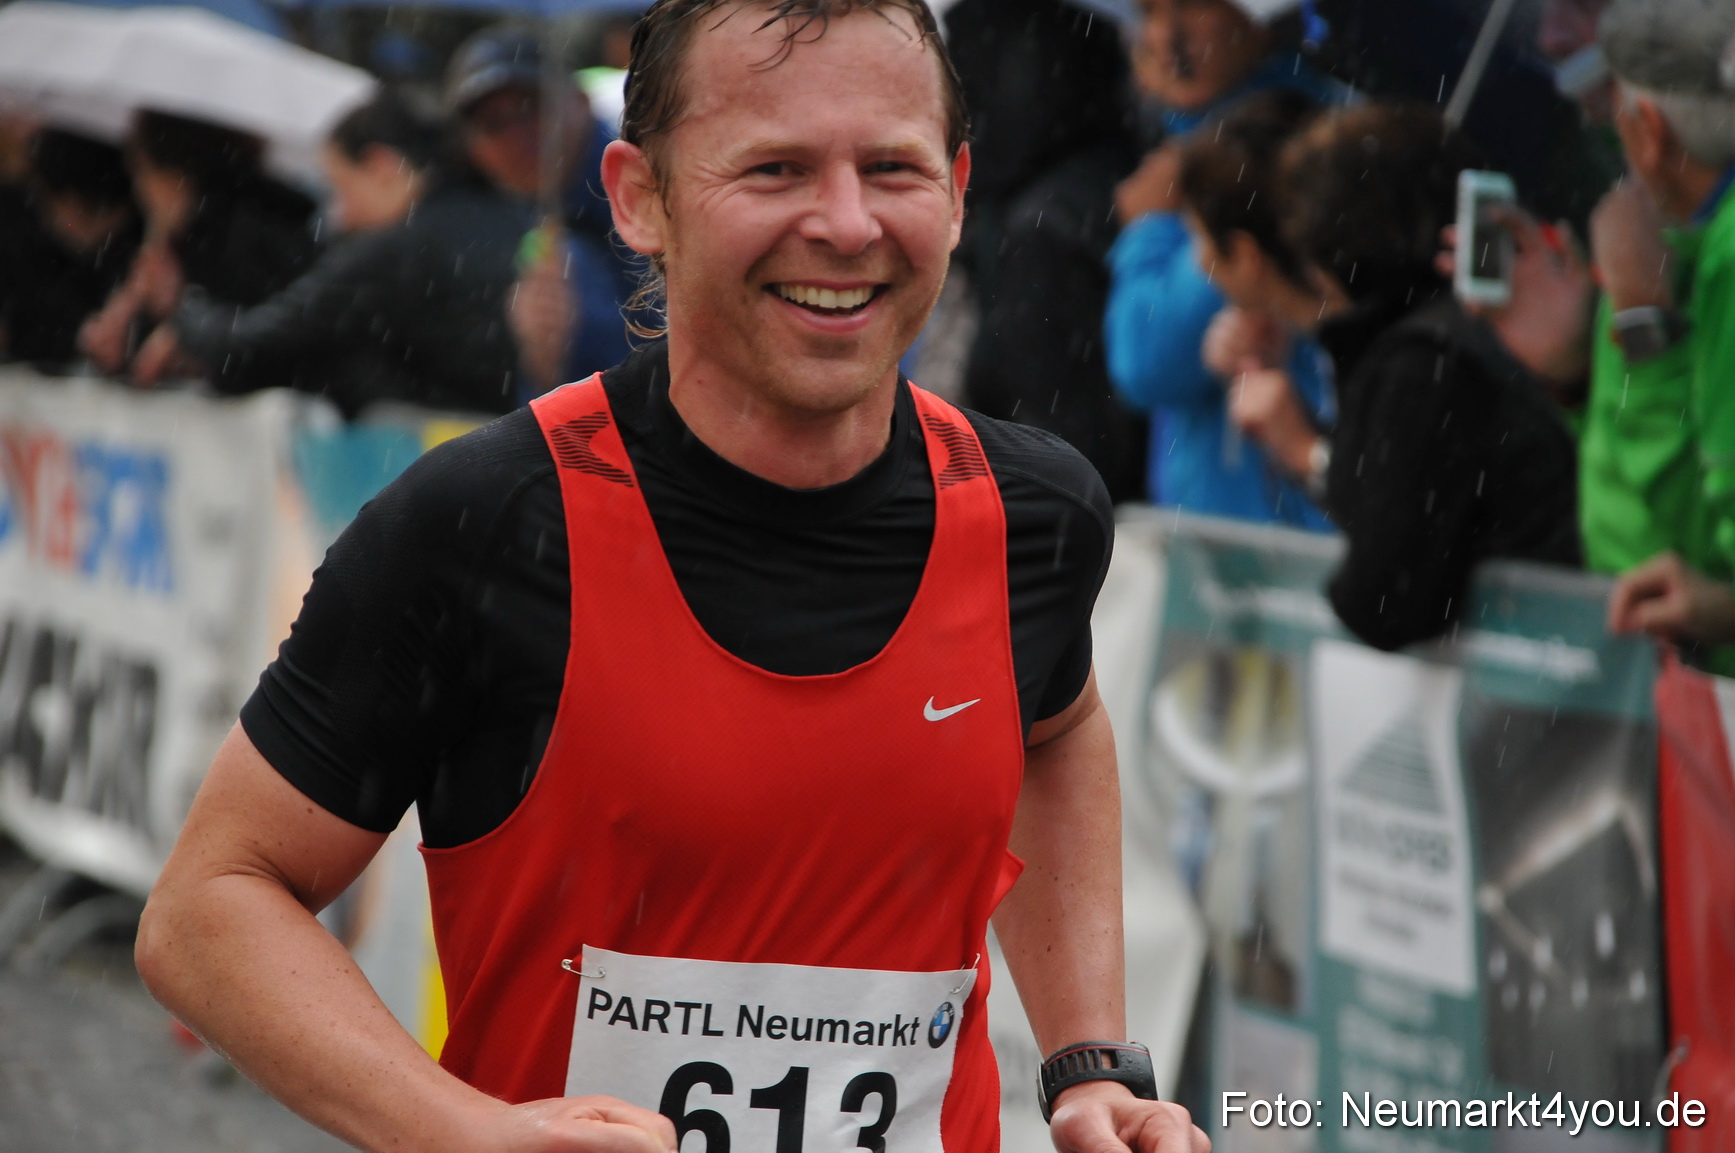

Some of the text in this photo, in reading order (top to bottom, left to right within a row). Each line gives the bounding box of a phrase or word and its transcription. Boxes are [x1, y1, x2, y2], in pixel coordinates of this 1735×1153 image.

[587, 987, 920, 1047] PARTL Neumarkt
[658, 1061, 897, 1153] 613
